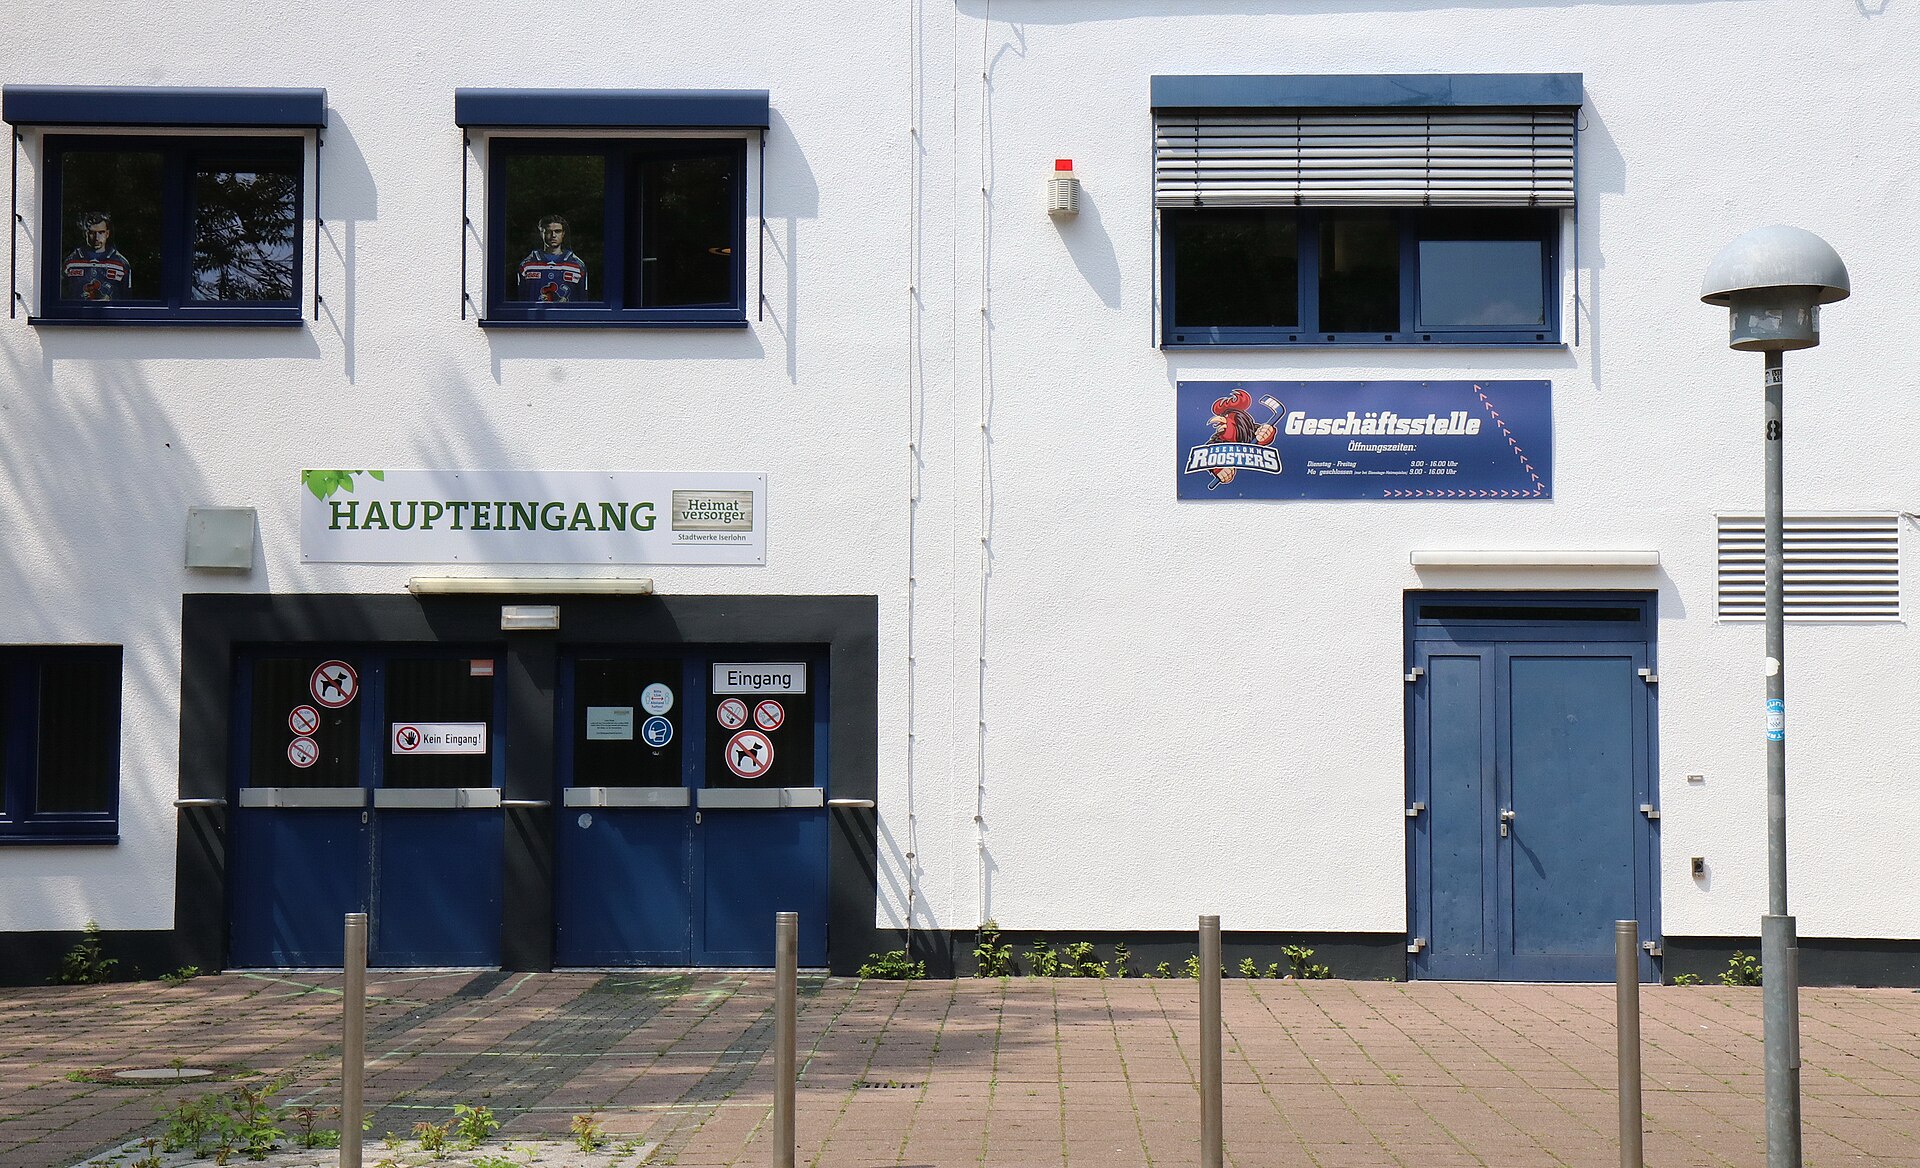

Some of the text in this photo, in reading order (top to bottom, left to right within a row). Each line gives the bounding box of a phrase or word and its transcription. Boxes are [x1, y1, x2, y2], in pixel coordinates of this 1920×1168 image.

[1285, 411, 1481, 436] Geschäftsstelle
[1348, 440, 1418, 454] Öffnungszeiten:
[1190, 448, 1279, 470] ROOSTERS
[1307, 460, 1332, 468] Dienstag
[1336, 460, 1357, 468] Freitag
[1447, 460, 1459, 468] Uhr
[1445, 468, 1457, 476] Uhr
[688, 499, 739, 511] Heimat
[328, 501, 657, 532] HAUPTEINGANG
[682, 511, 745, 524] versorger
[678, 533, 746, 541] Stadtwerke Iserlohn
[727, 670, 792, 689] Eingang
[423, 734, 481, 746] Kein Eingang!
